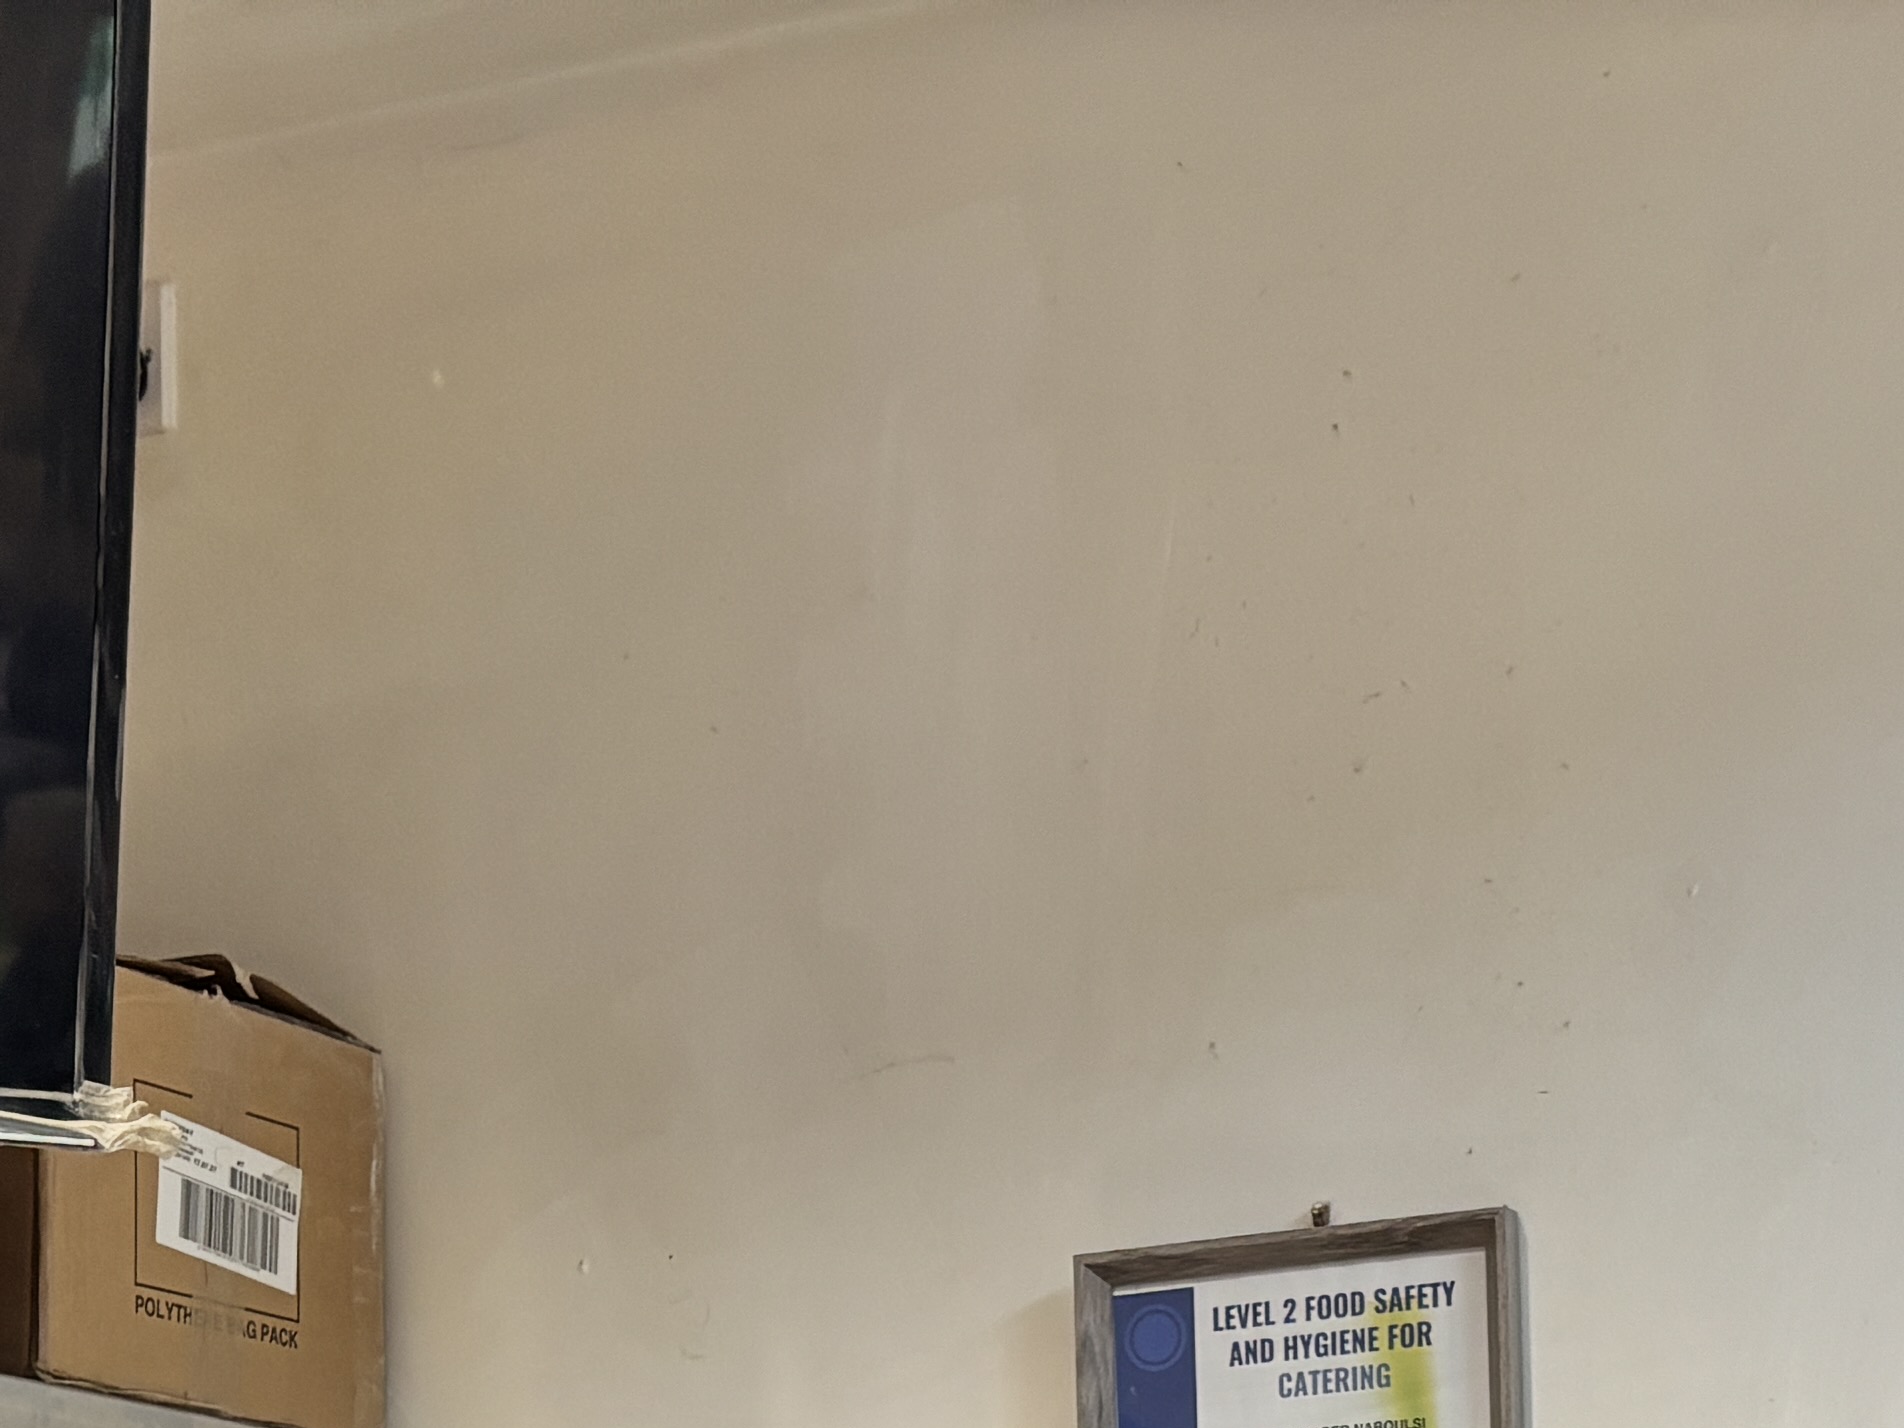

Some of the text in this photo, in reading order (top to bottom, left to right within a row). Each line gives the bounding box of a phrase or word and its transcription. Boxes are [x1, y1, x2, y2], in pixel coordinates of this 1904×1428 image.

[1213, 1280, 1456, 1332] LEVEL 2 FOOD SAFETY
[260, 1323, 299, 1350] PACK
[1229, 1321, 1433, 1367] AND HYGIENE FOR
[1278, 1362, 1392, 1399] CATERING
